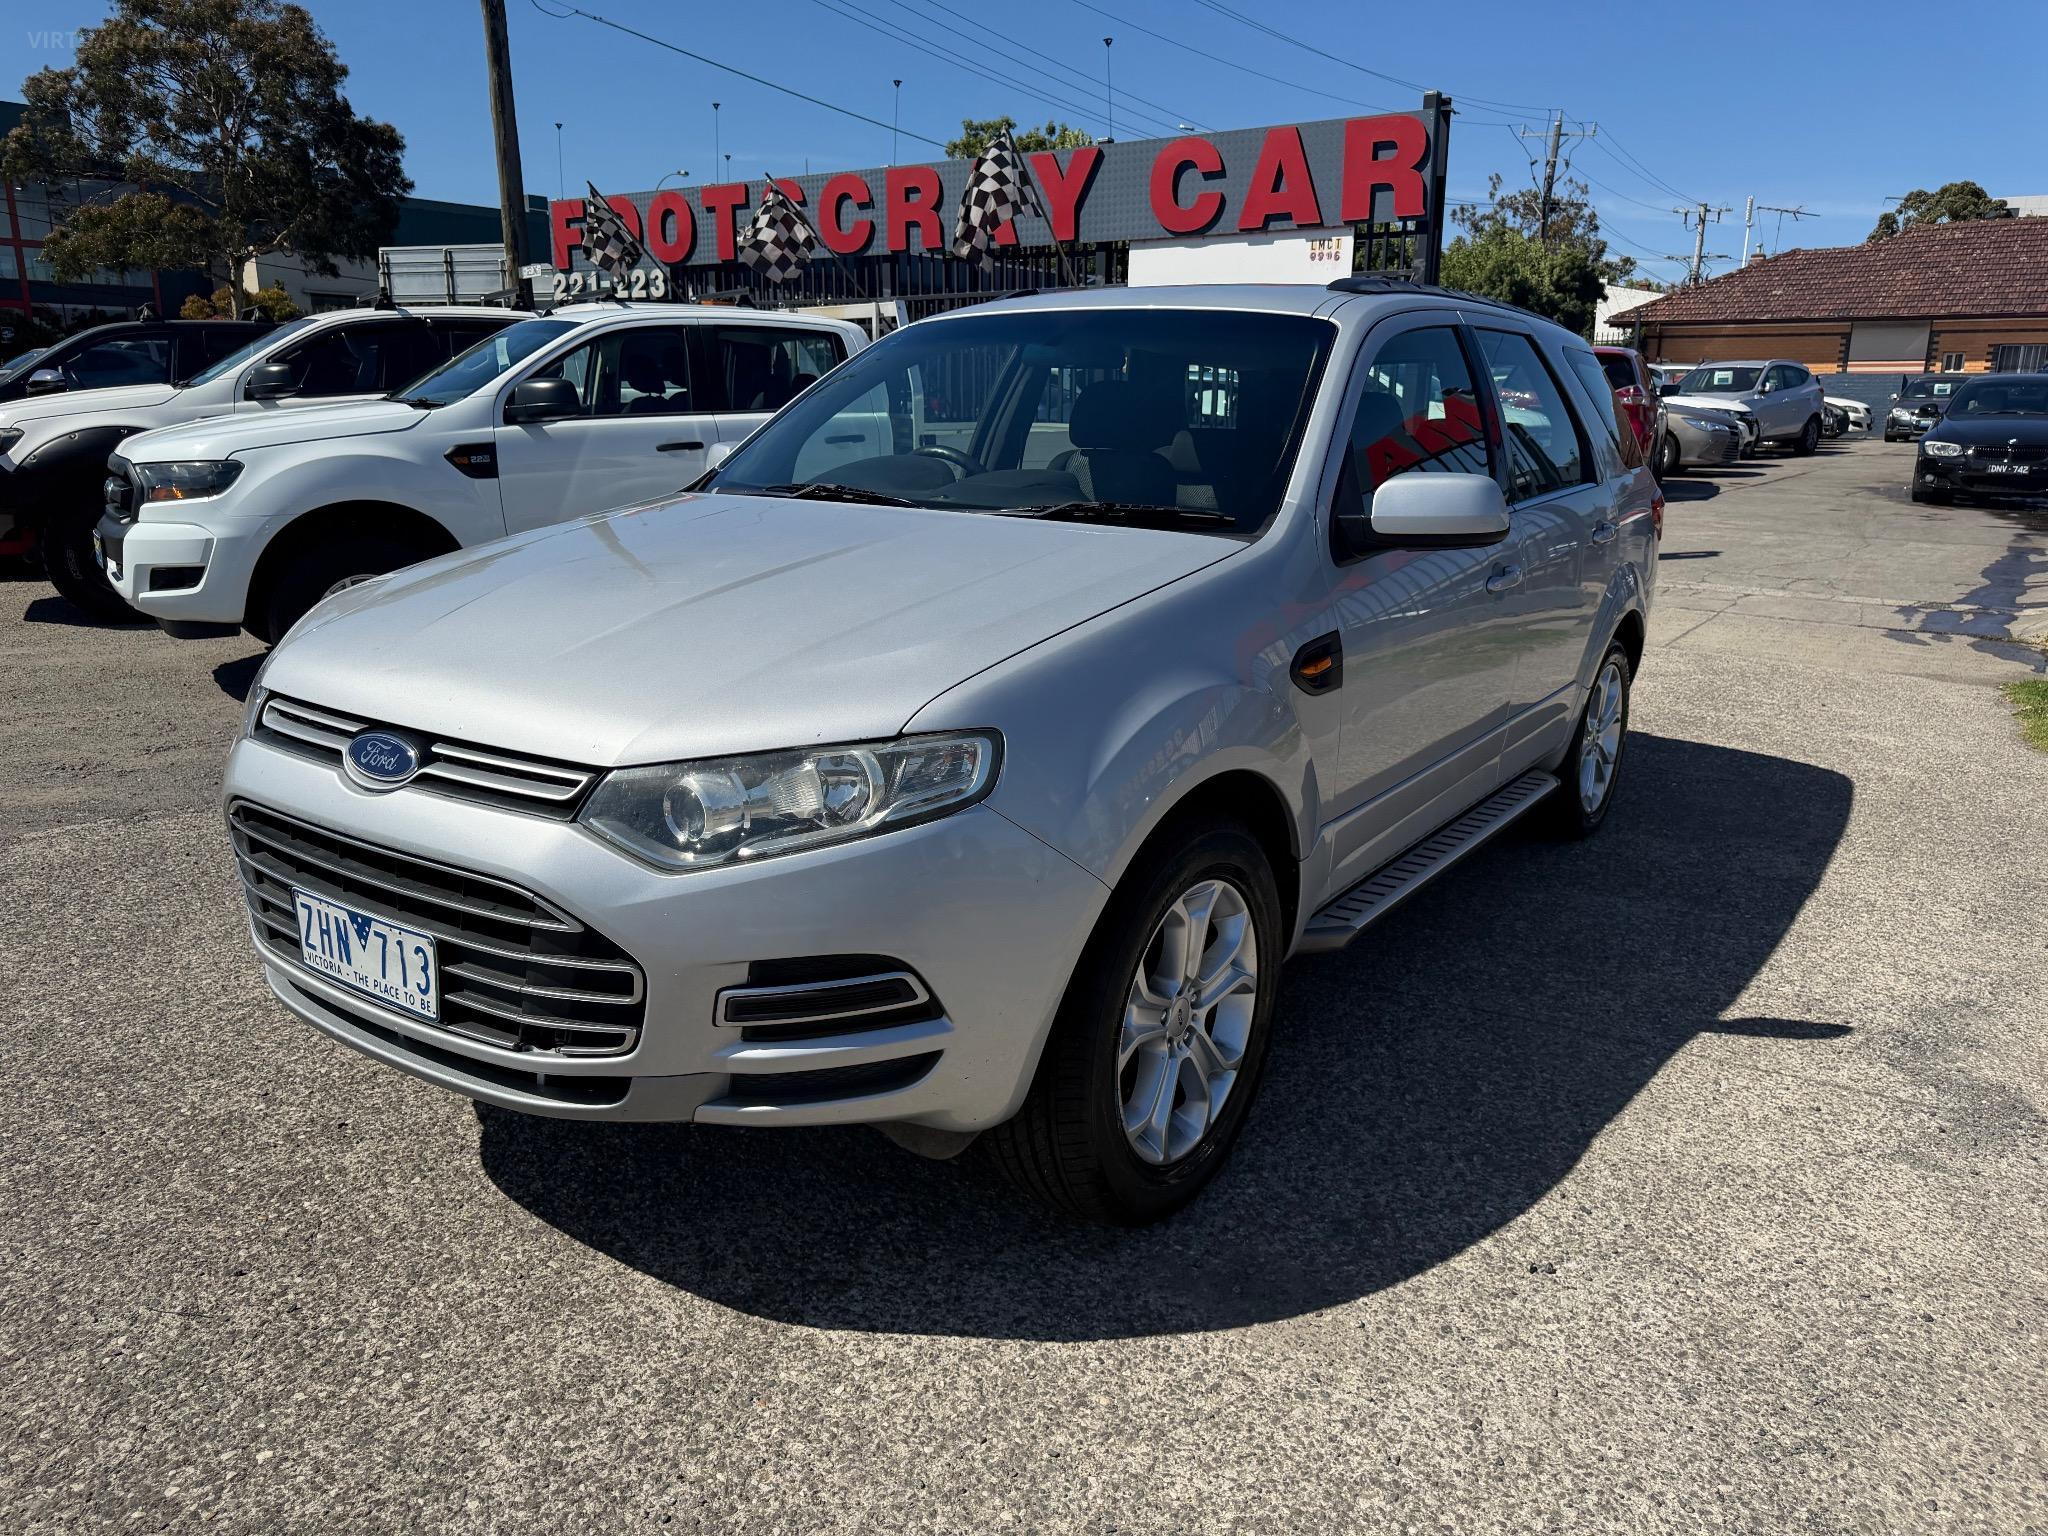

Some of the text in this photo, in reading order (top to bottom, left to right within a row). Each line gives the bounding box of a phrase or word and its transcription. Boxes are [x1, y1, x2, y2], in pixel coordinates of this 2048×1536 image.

[550, 114, 1429, 270] FOTCRY CAR
[360, 740, 400, 771] Ford
[300, 901, 431, 996] ZHN 713
[306, 951, 343, 976] VICTORIA
[353, 970, 369, 988] THE
[373, 979, 400, 1000] PLACE
[404, 991, 416, 1006] TO
[420, 1000, 431, 1013] BE
